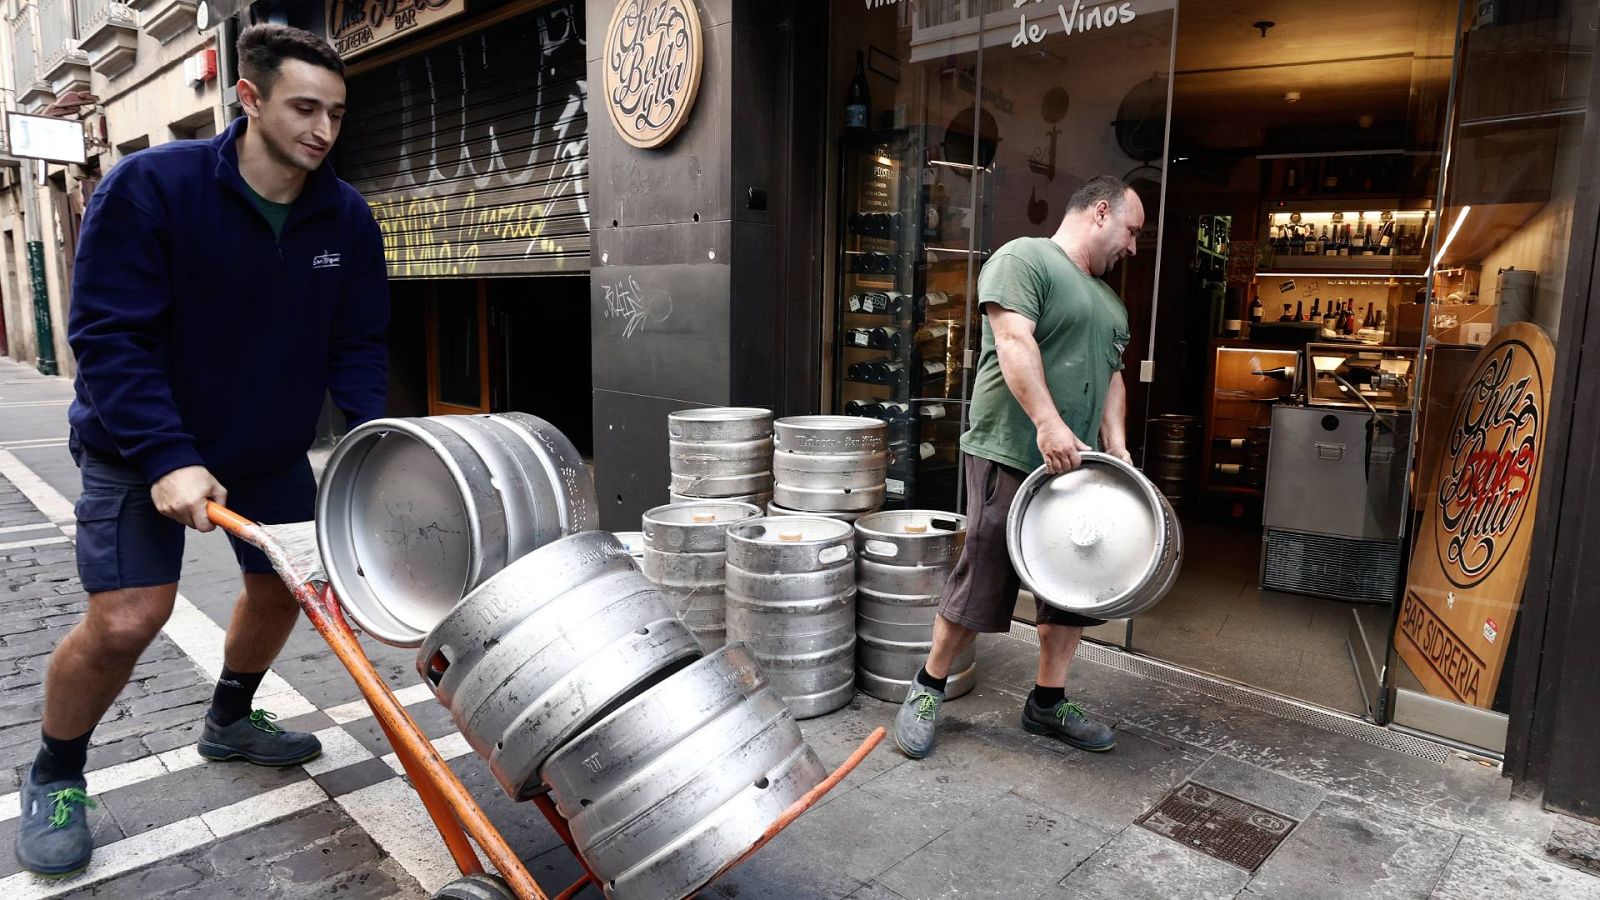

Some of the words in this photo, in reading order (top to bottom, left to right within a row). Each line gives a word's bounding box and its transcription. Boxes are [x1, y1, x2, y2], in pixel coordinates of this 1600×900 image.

[394, 9, 418, 30] BAR
[612, 0, 684, 70] Chez
[1011, 13, 1048, 49] de
[1057, 0, 1136, 36] Vinos
[619, 31, 676, 93] Bela
[312, 256, 323, 266] San
[1450, 346, 1534, 456] Chez
[1403, 596, 1424, 641] BAR
[1423, 623, 1483, 706] SIDRERIA
